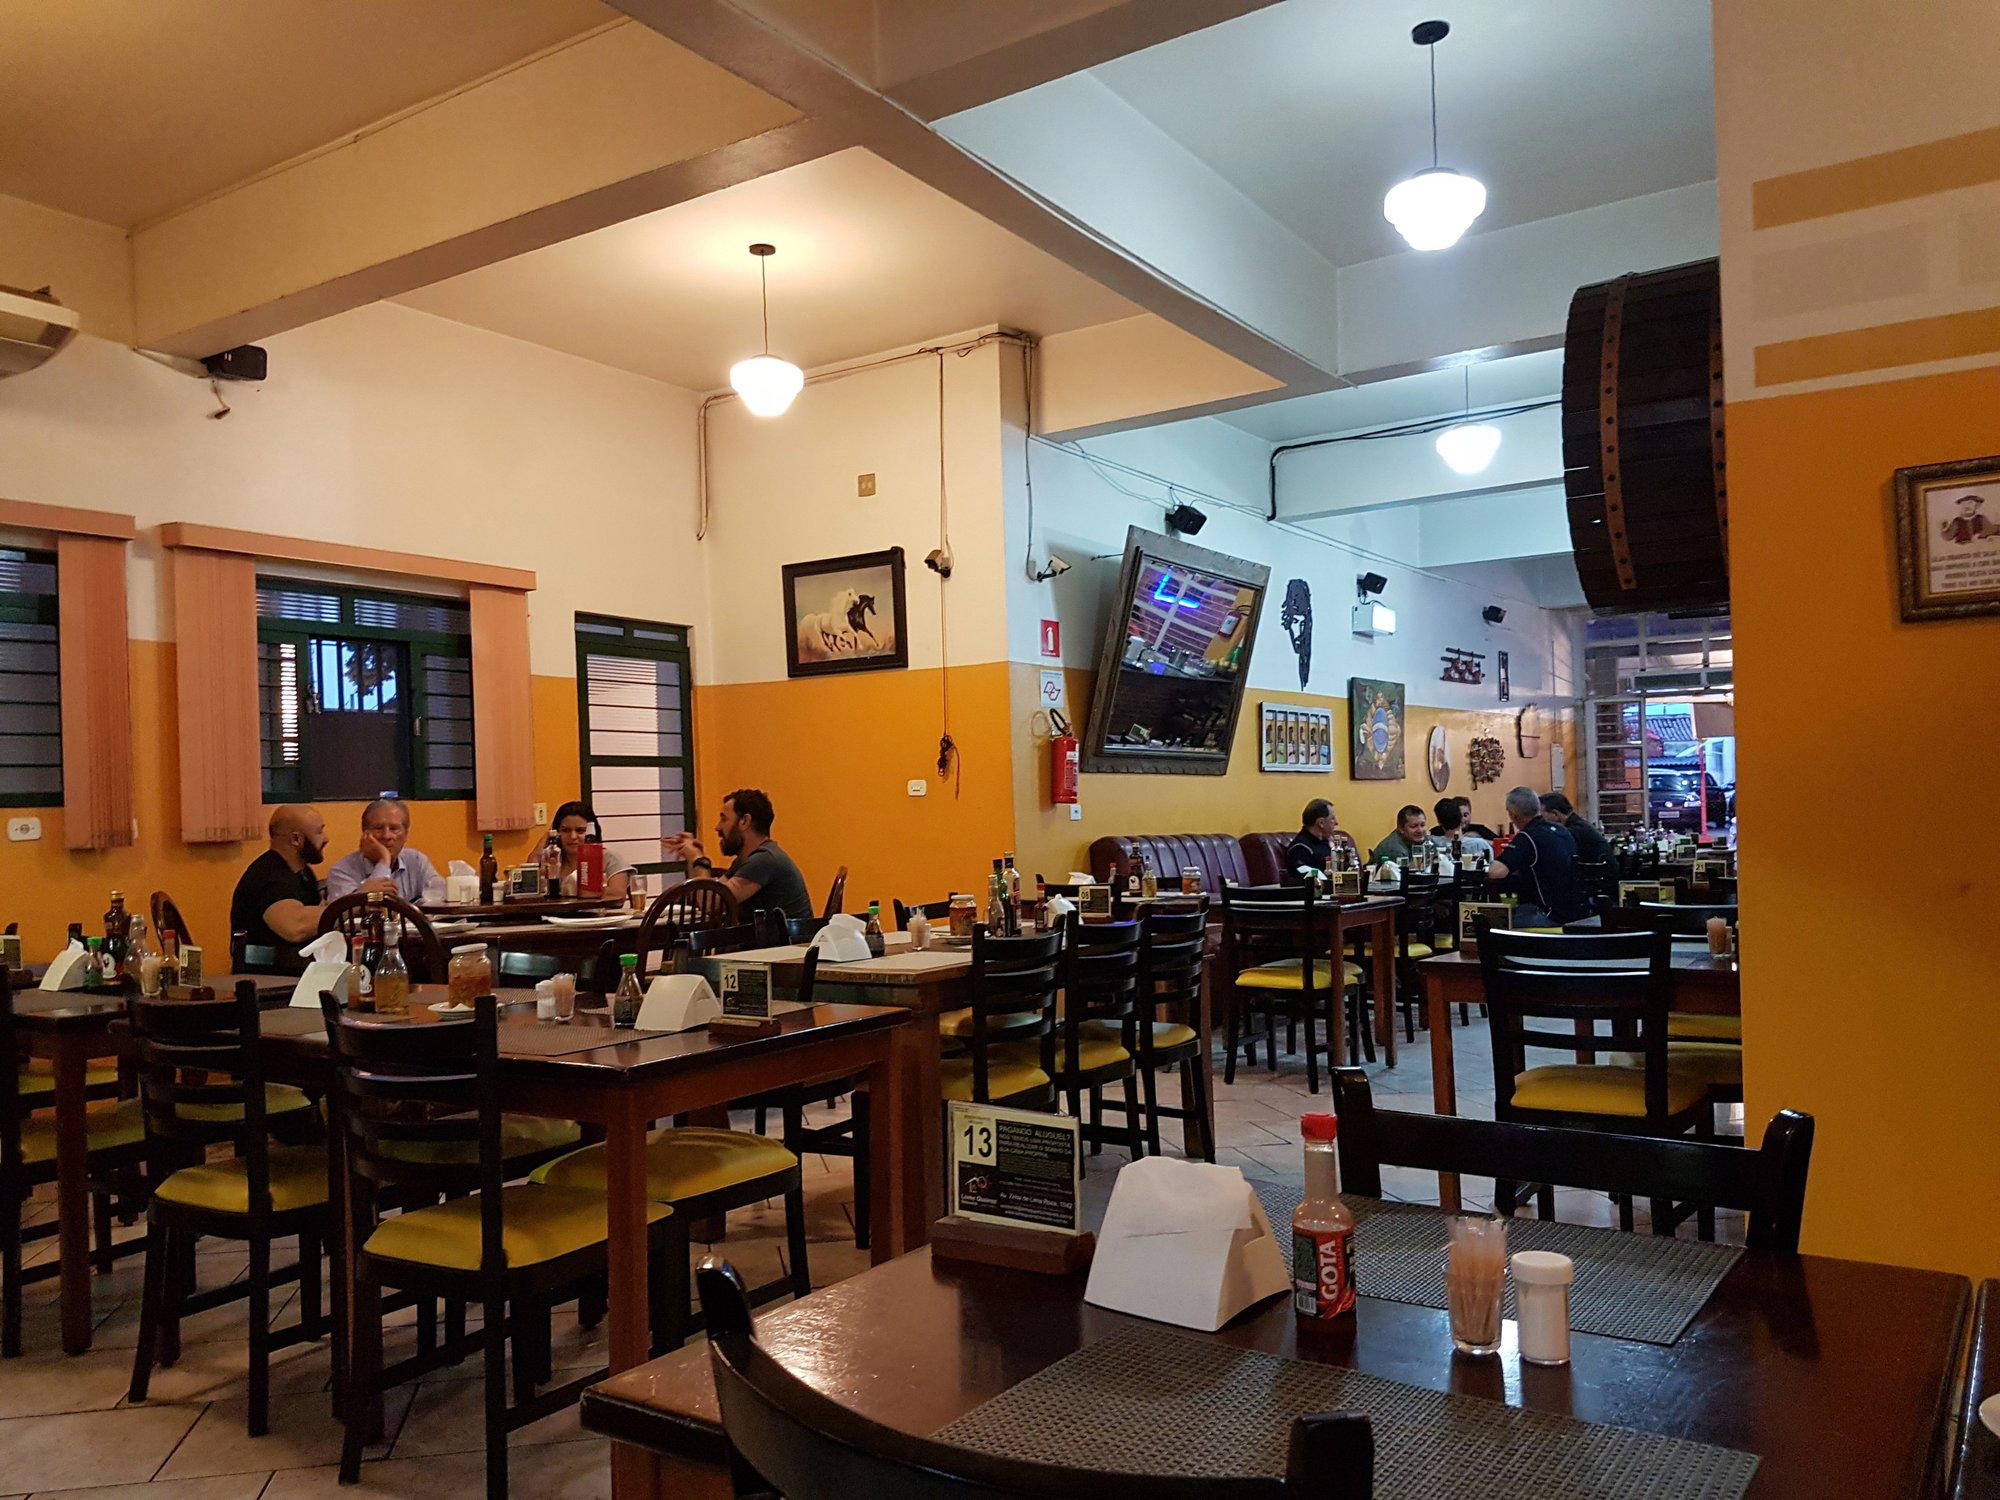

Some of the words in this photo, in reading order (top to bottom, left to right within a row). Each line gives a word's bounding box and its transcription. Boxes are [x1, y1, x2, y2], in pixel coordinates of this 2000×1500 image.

[725, 974, 736, 988] 12
[964, 1125, 992, 1157] 13
[1320, 1240, 1337, 1300] GOTA
